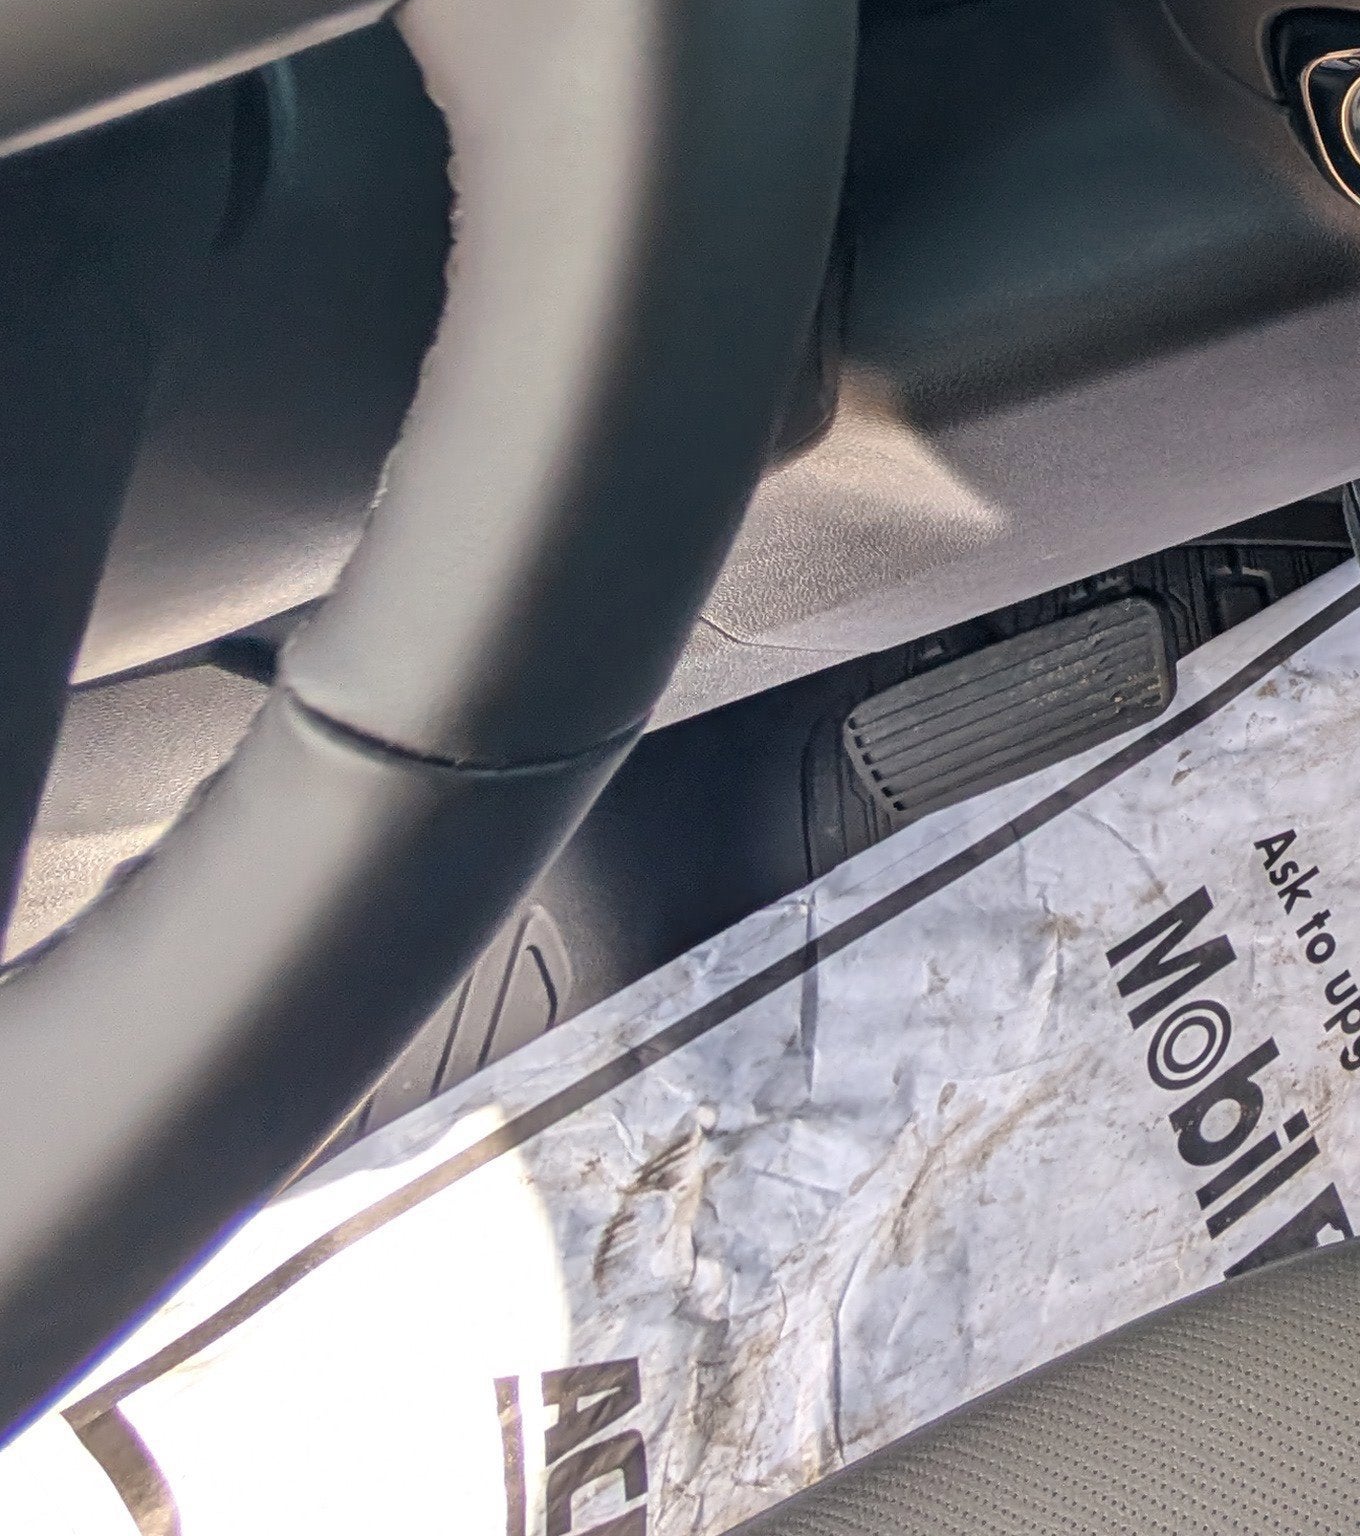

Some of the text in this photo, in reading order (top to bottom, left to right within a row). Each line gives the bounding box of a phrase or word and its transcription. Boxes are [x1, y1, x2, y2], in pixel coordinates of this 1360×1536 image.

[1254, 829, 1319, 915] Ask
[1296, 909, 1336, 964] to
[1105, 885, 1320, 1239] Mobil
